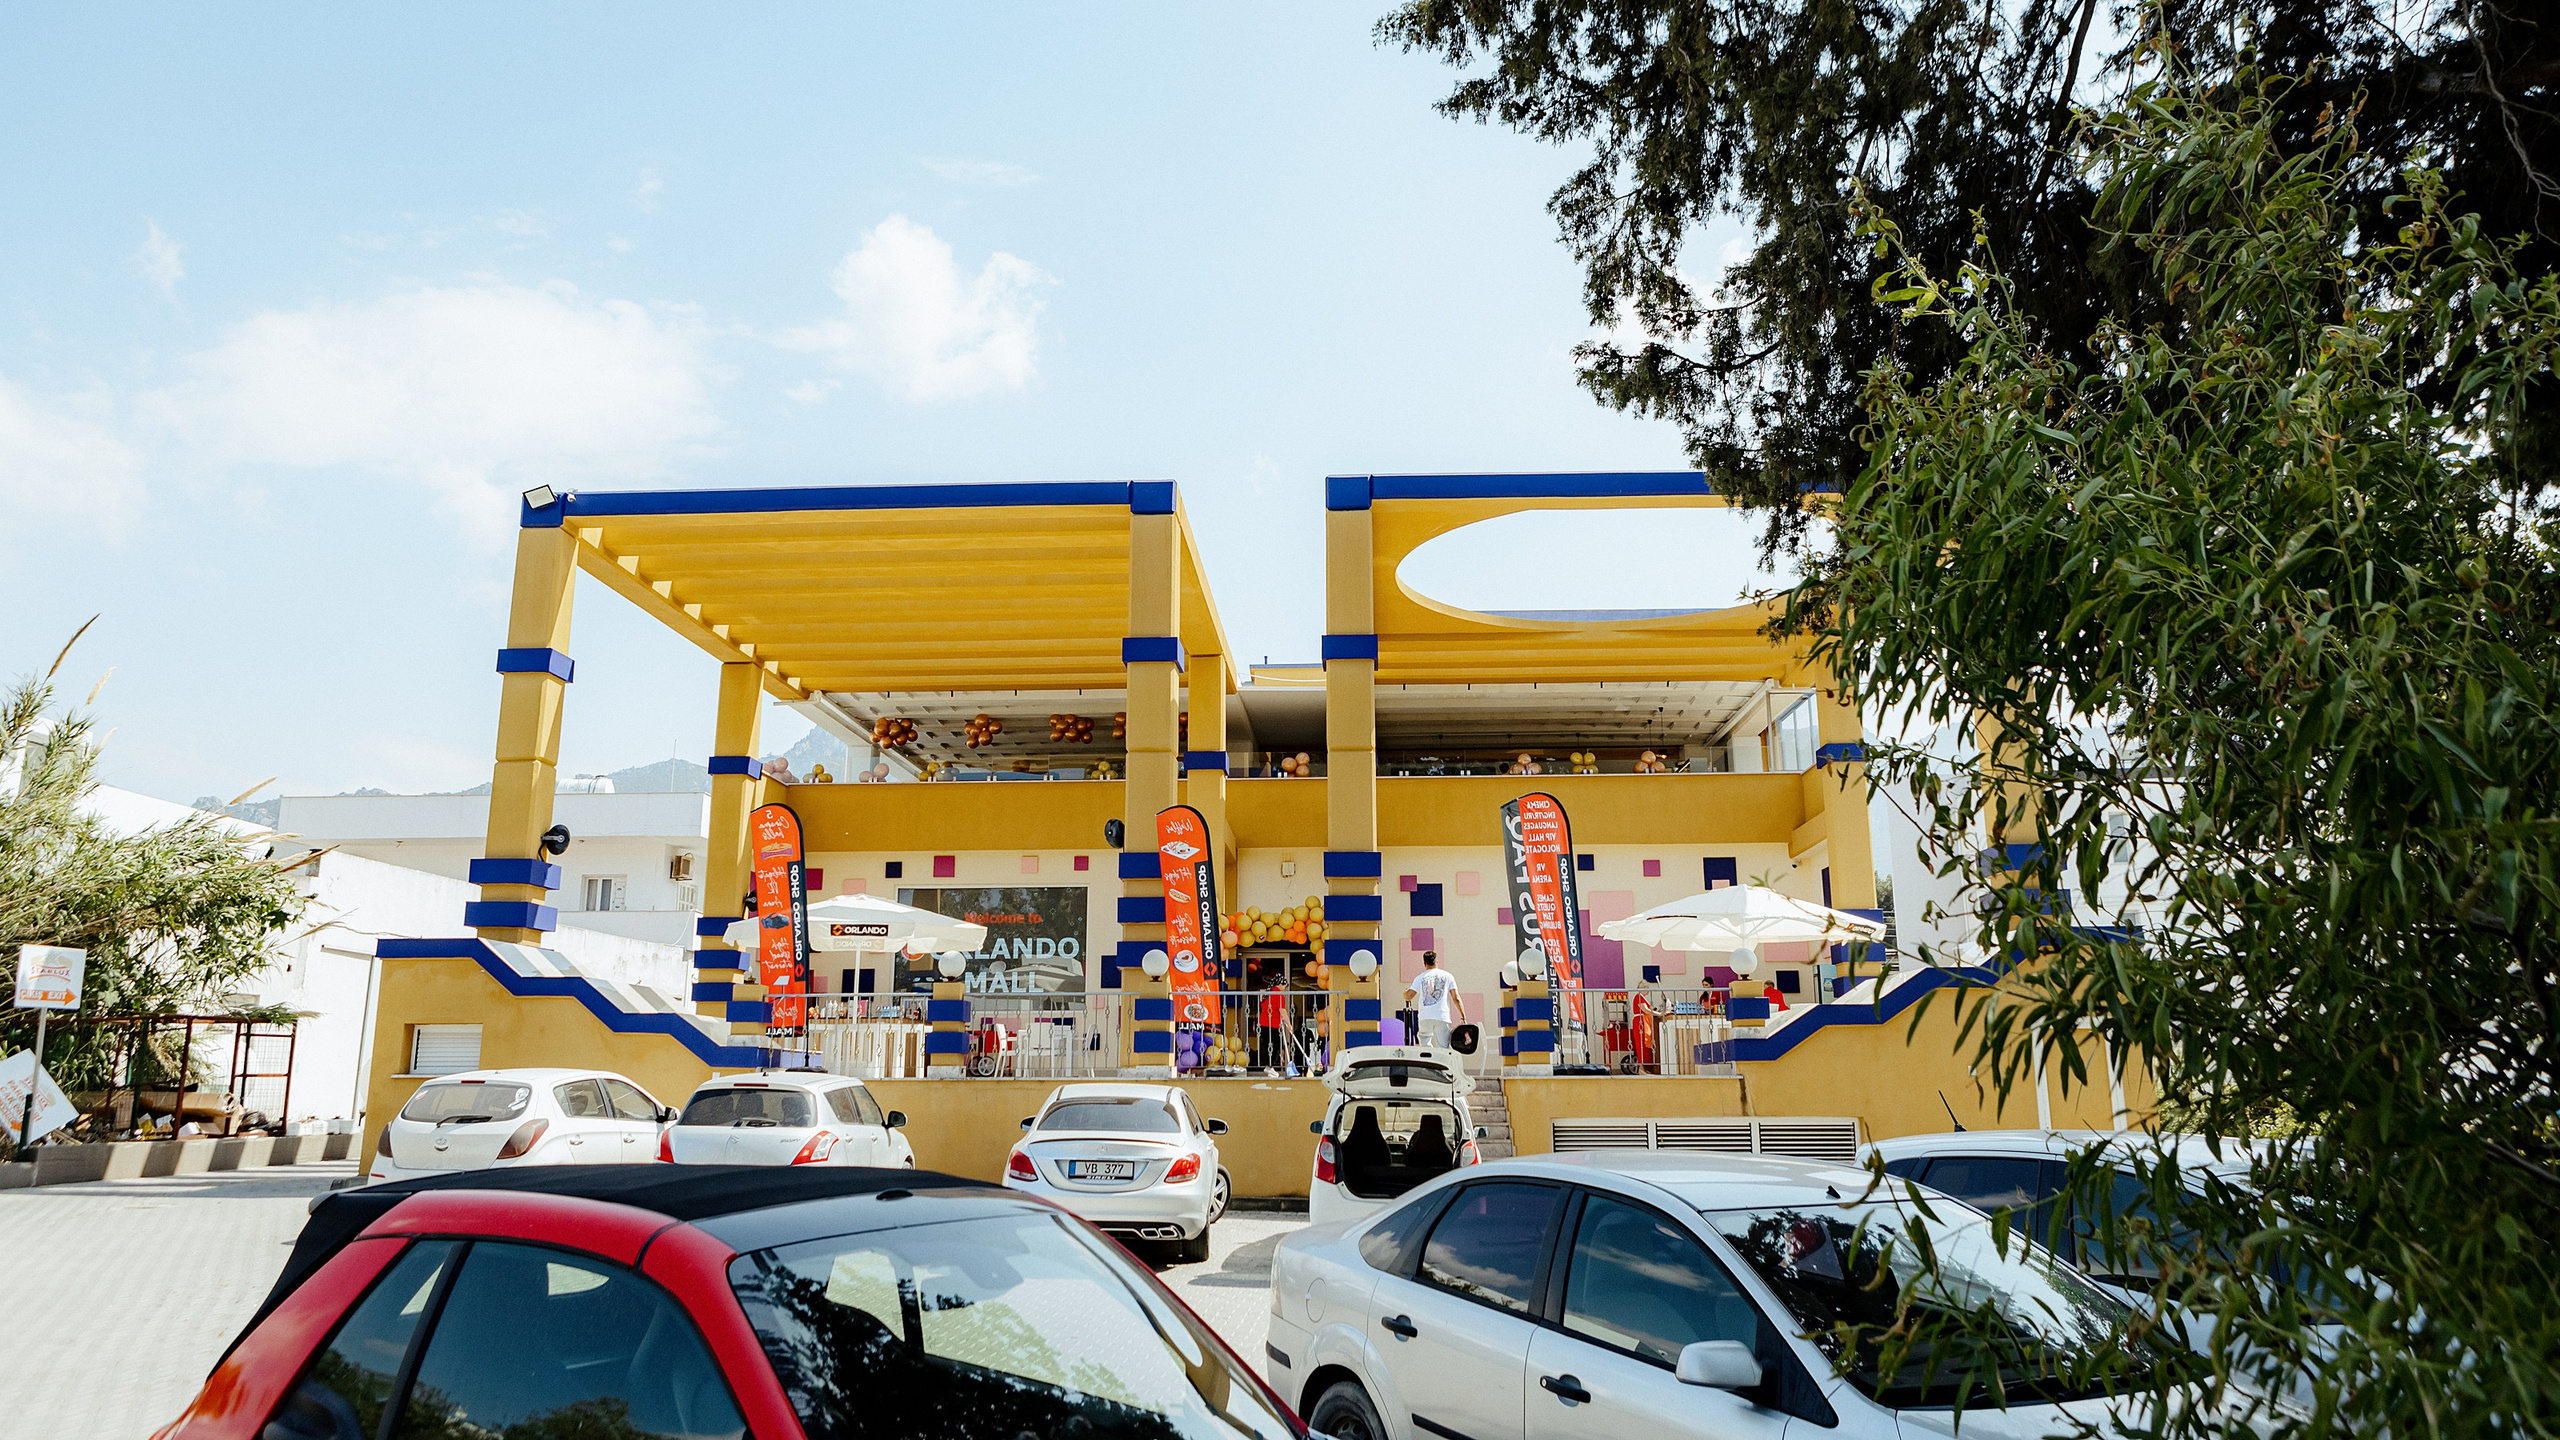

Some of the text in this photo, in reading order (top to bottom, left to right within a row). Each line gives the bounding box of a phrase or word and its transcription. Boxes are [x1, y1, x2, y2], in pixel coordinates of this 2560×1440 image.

[964, 912, 1042, 924] Welcome to
[844, 926, 887, 935] ORLANDO
[964, 971, 1044, 993] MALL
[47, 990, 66, 1000] EXIT
[1085, 1163, 1124, 1174] YB 377
